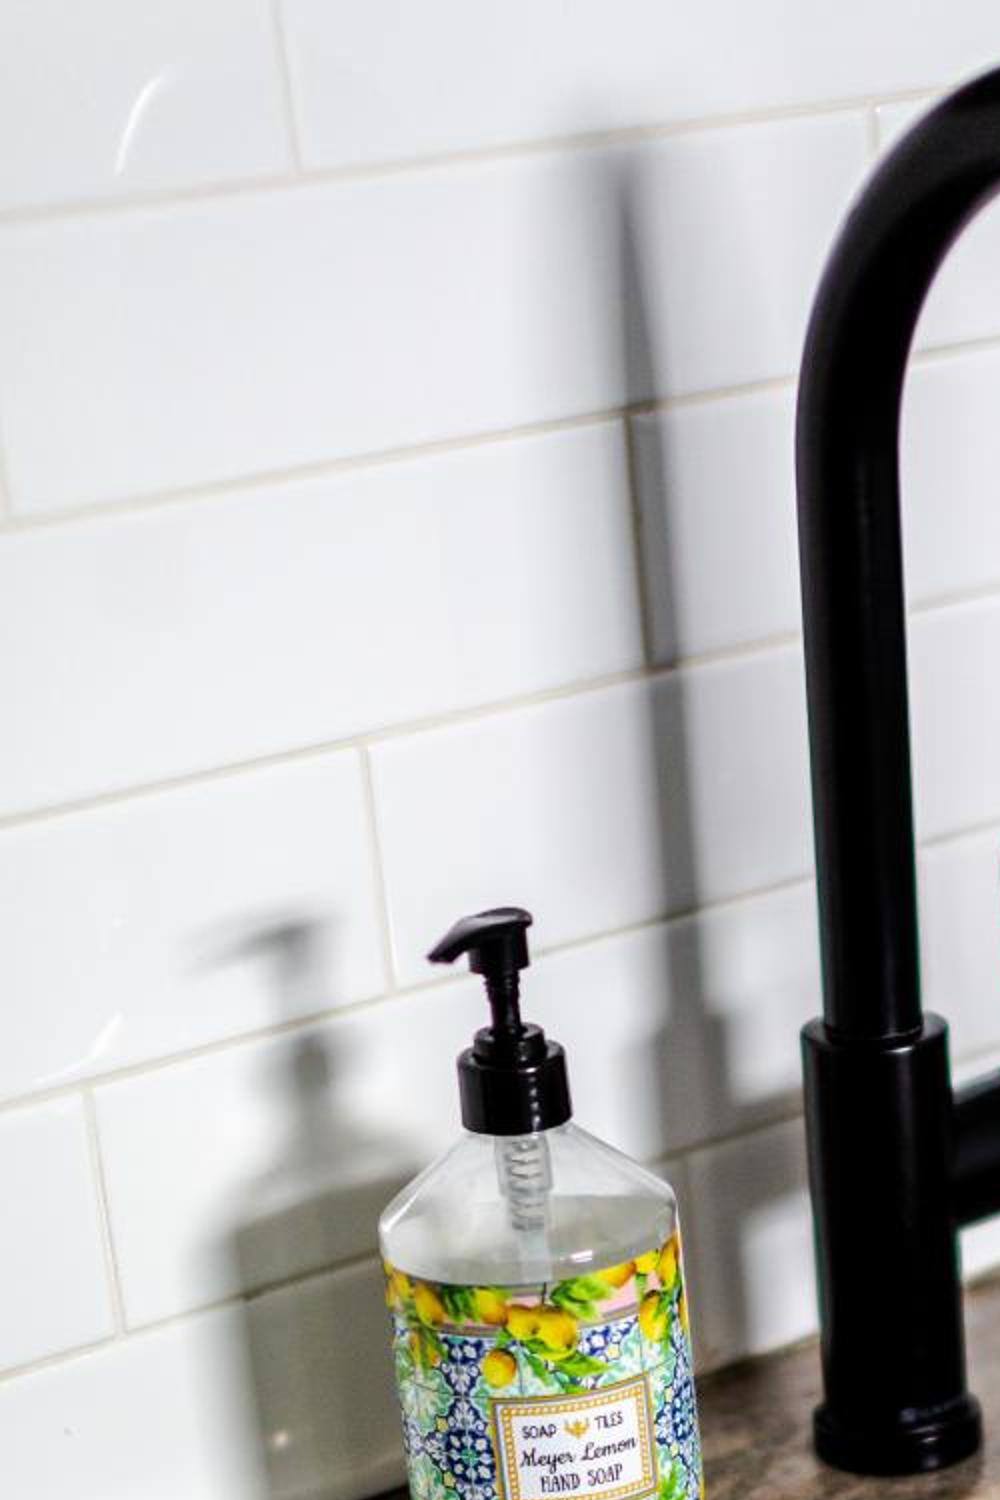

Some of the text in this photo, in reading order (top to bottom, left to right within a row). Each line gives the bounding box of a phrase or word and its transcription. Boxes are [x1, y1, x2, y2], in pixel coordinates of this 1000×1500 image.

[521, 1411, 624, 1440] SOAP TILES
[520, 1437, 637, 1474] Meyer Lemon
[540, 1463, 624, 1493] HAND SOAP
